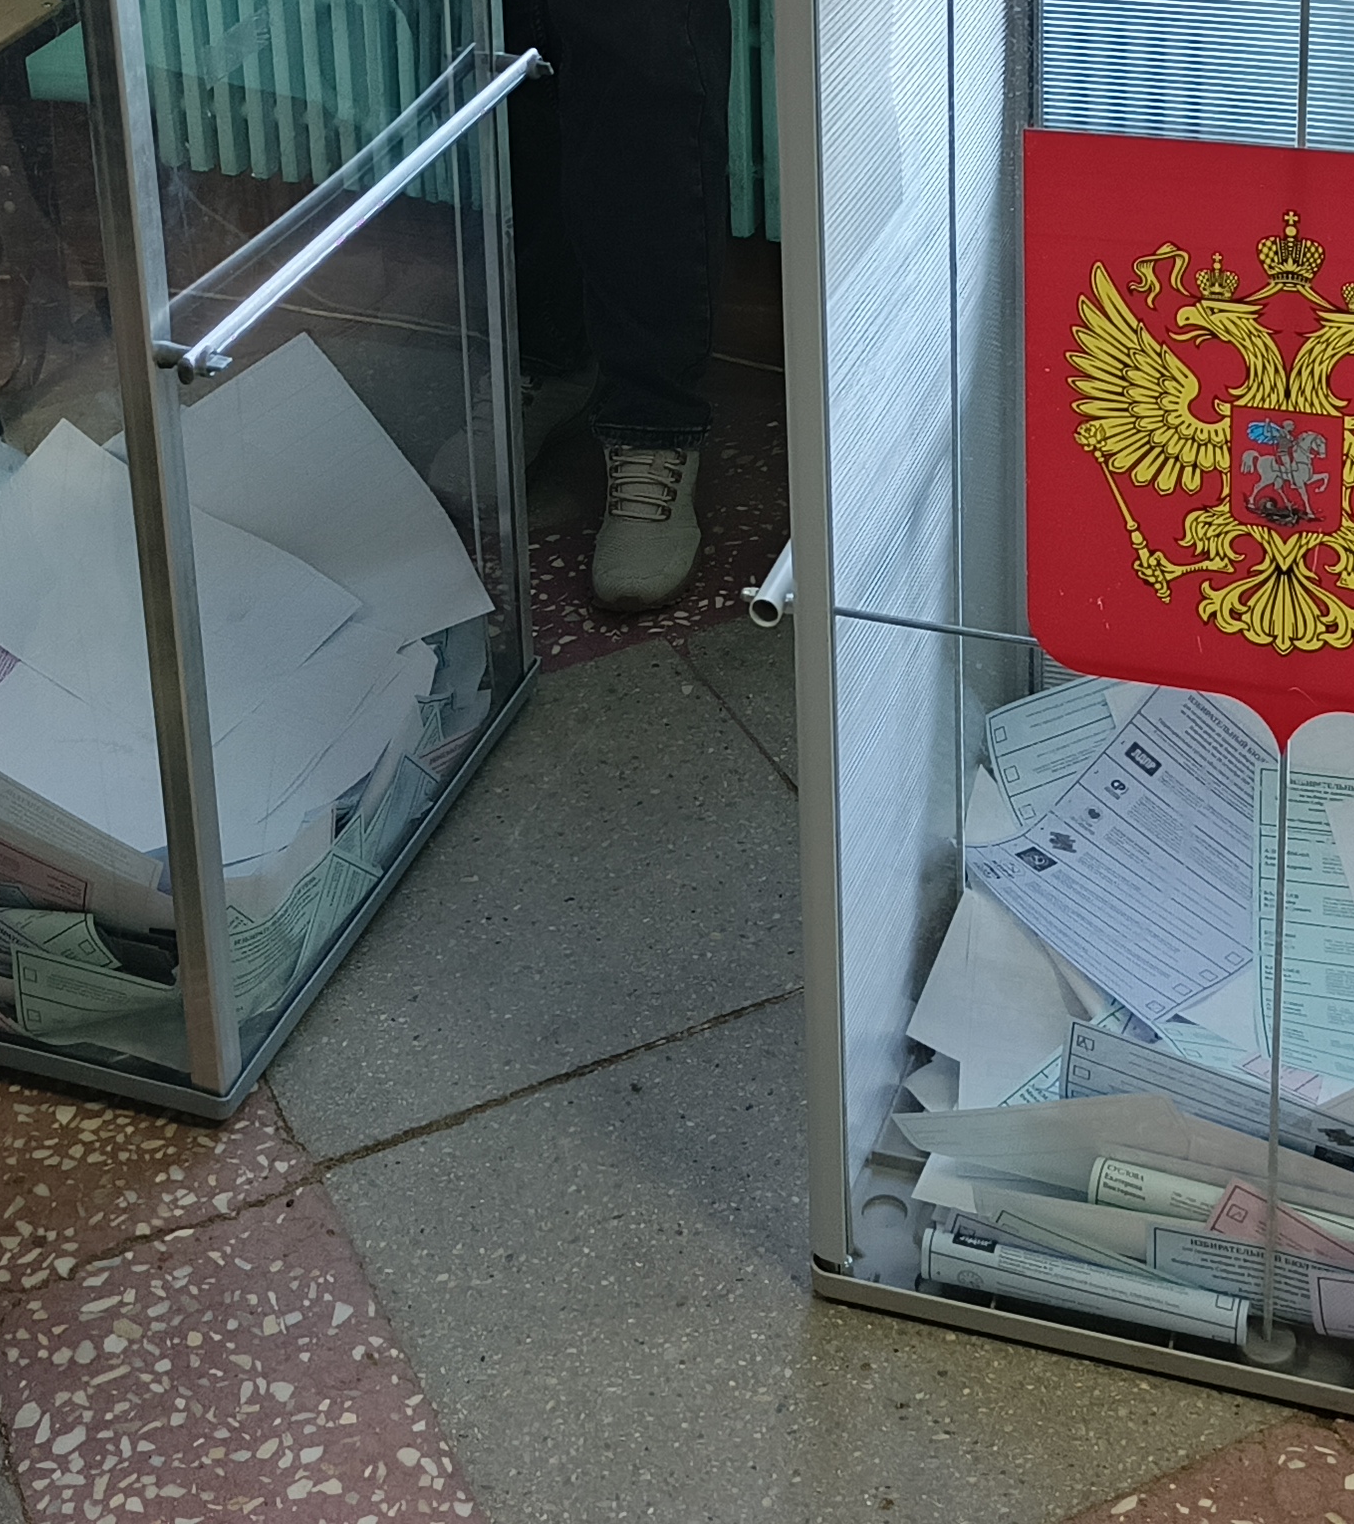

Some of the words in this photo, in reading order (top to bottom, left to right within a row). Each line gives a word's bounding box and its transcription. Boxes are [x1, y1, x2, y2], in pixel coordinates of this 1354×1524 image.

[1188, 695, 1249, 751] ИЗБИРАТЕЛЬНЫЙ
[1246, 745, 1269, 764] БЮЛ
[1190, 1238, 1283, 1264] ИЗБИРАТЕЛЬНЙ
